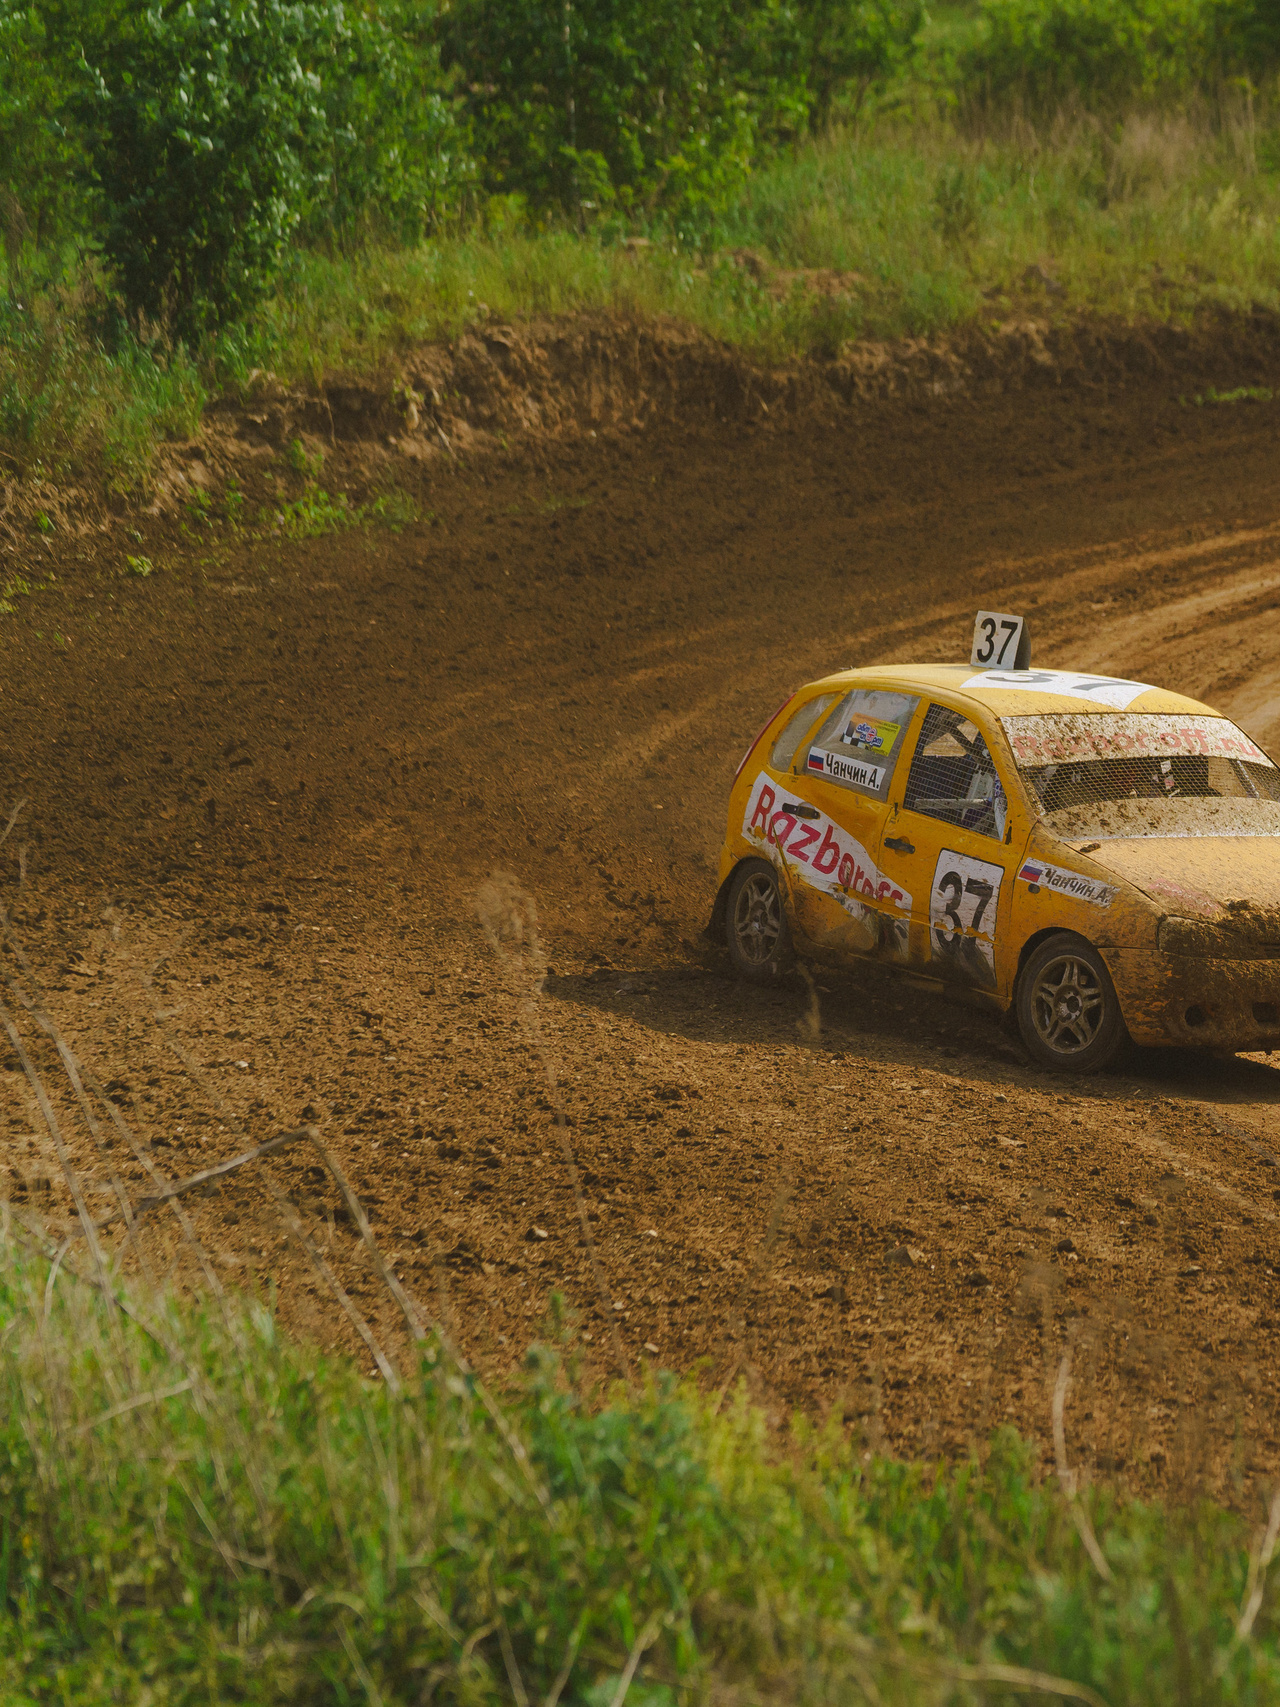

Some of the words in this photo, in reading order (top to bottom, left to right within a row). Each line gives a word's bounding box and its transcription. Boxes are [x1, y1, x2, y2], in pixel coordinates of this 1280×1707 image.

[977, 618, 1018, 665] 37
[986, 672, 1142, 691] 37
[826, 753, 867, 785] Чанчин
[1044, 867, 1095, 898] Чанчин
[936, 871, 994, 949] 37
